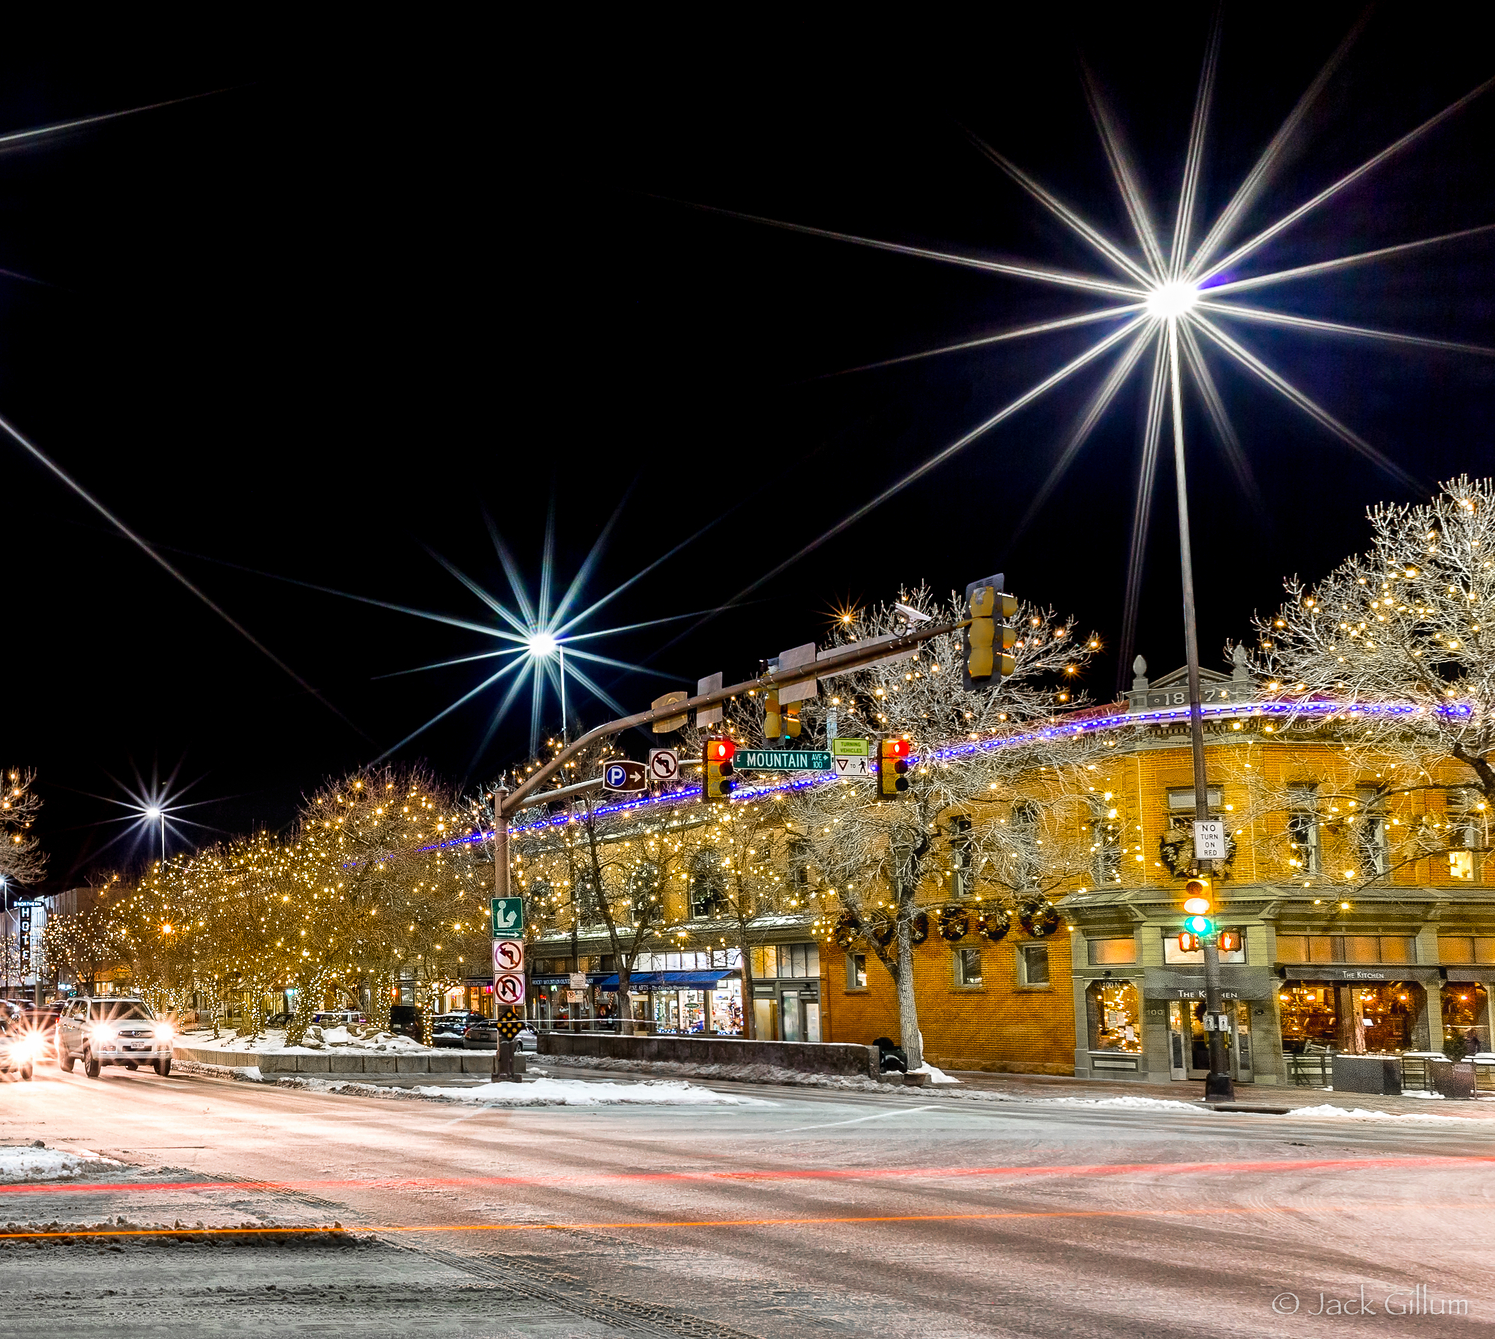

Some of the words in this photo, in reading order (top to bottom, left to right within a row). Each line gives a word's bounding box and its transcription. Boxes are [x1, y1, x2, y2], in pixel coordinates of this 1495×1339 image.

[746, 753, 808, 768] MOUNTAIN
[812, 761, 823, 769] 100
[611, 768, 622, 783] P
[1342, 971, 1355, 979] THE
[1357, 971, 1384, 979] KITCHEN
[1177, 989, 1195, 998] THE
[1198, 989, 1238, 998] KHEN
